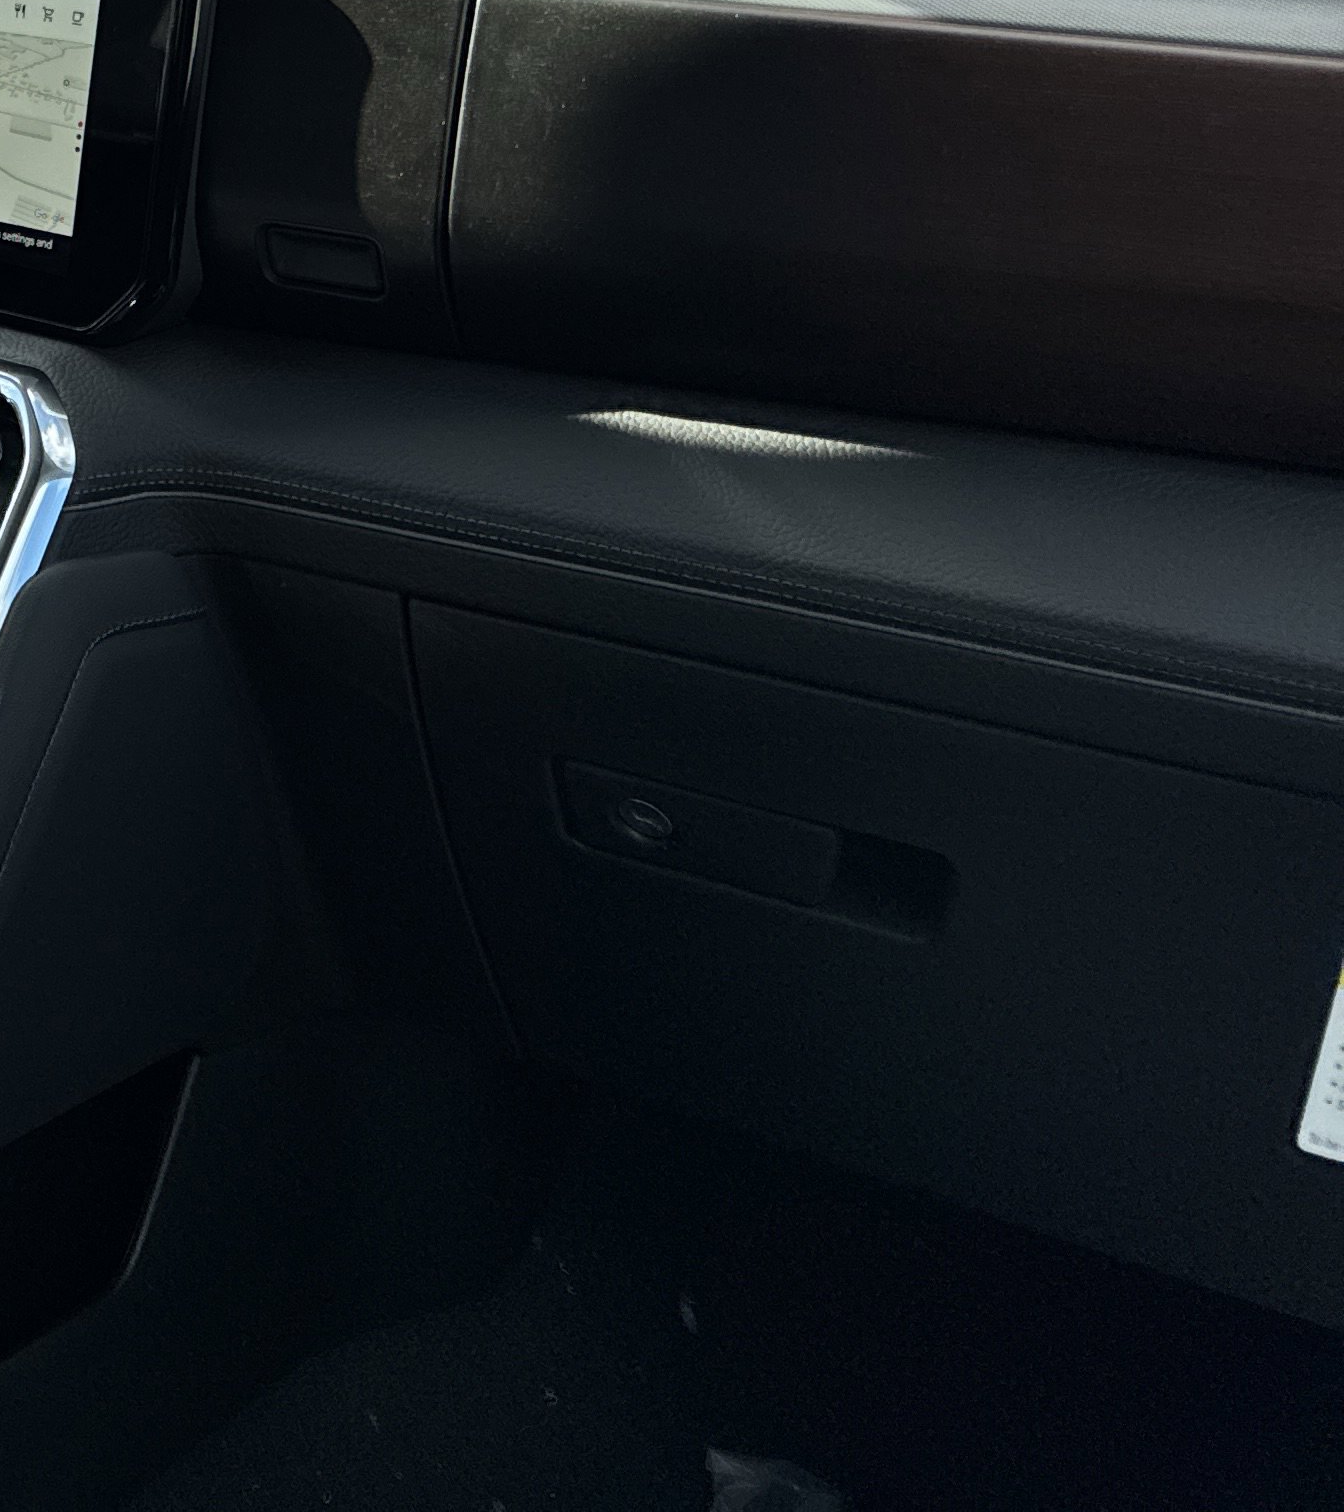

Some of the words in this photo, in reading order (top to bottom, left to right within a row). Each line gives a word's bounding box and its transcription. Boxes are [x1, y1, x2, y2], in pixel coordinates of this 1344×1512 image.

[34, 207, 65, 225] Gogle
[2, 231, 35, 248] settings
[35, 238, 54, 250] and
